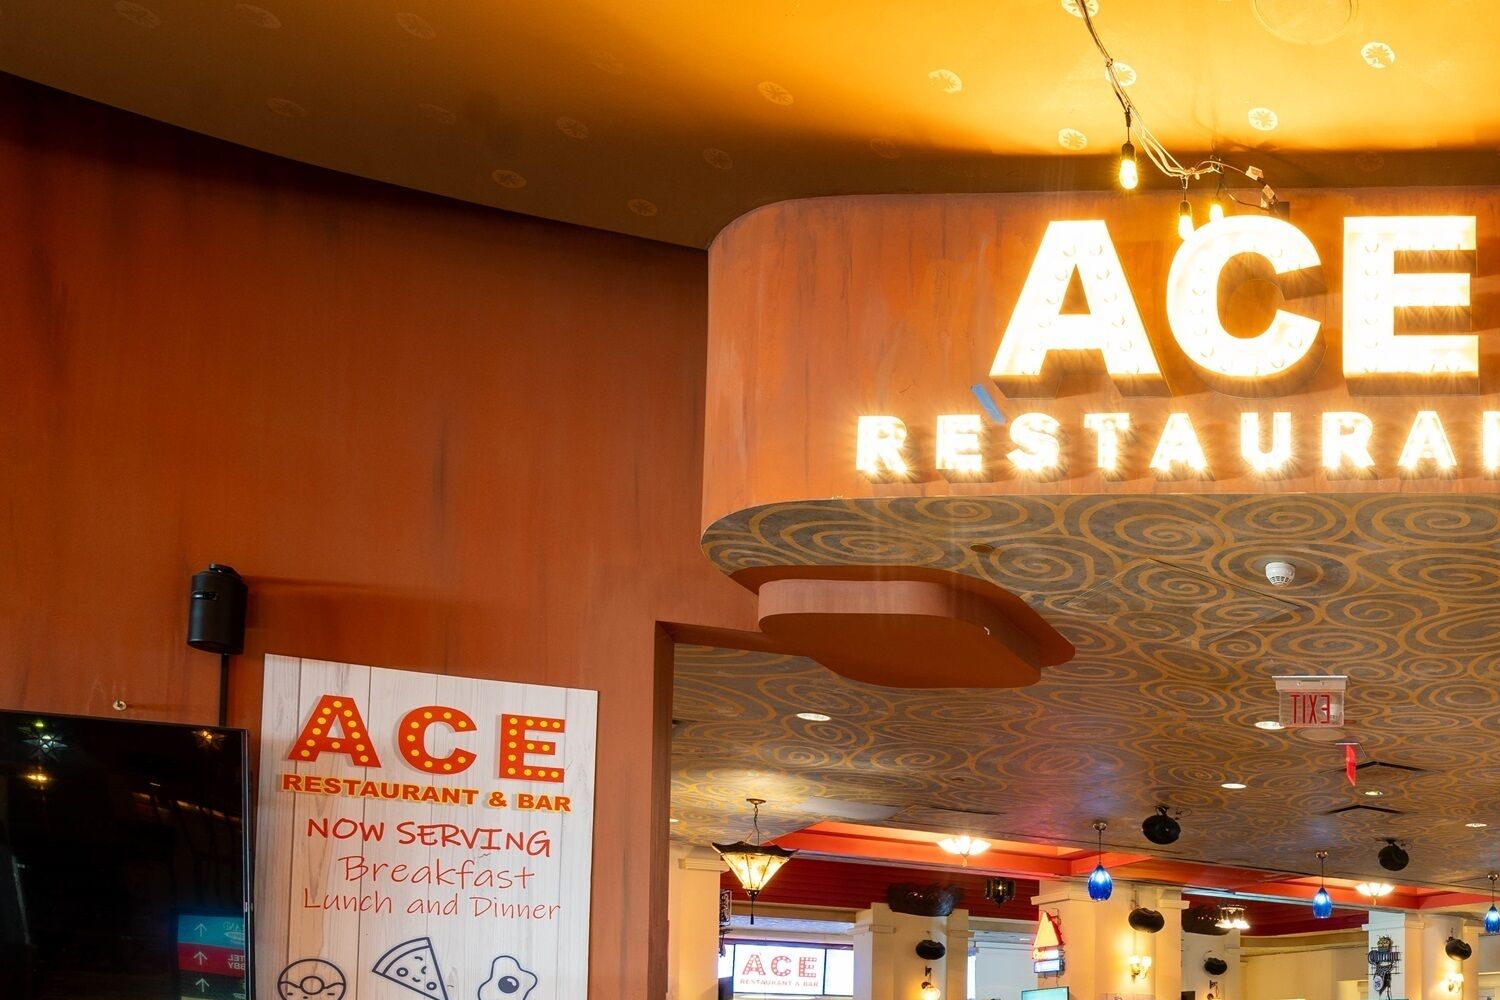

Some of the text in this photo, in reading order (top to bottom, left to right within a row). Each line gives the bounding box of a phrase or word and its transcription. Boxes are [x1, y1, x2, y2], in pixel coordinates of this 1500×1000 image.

[989, 214, 1479, 385] ACE
[287, 694, 566, 783] ACE
[283, 774, 571, 812] RESTAURANT & BAR
[307, 818, 551, 857] NOW SERVING
[338, 855, 535, 889] Breakfast
[304, 888, 561, 919] Lunch and Dinner
[742, 954, 817, 978] ACE
